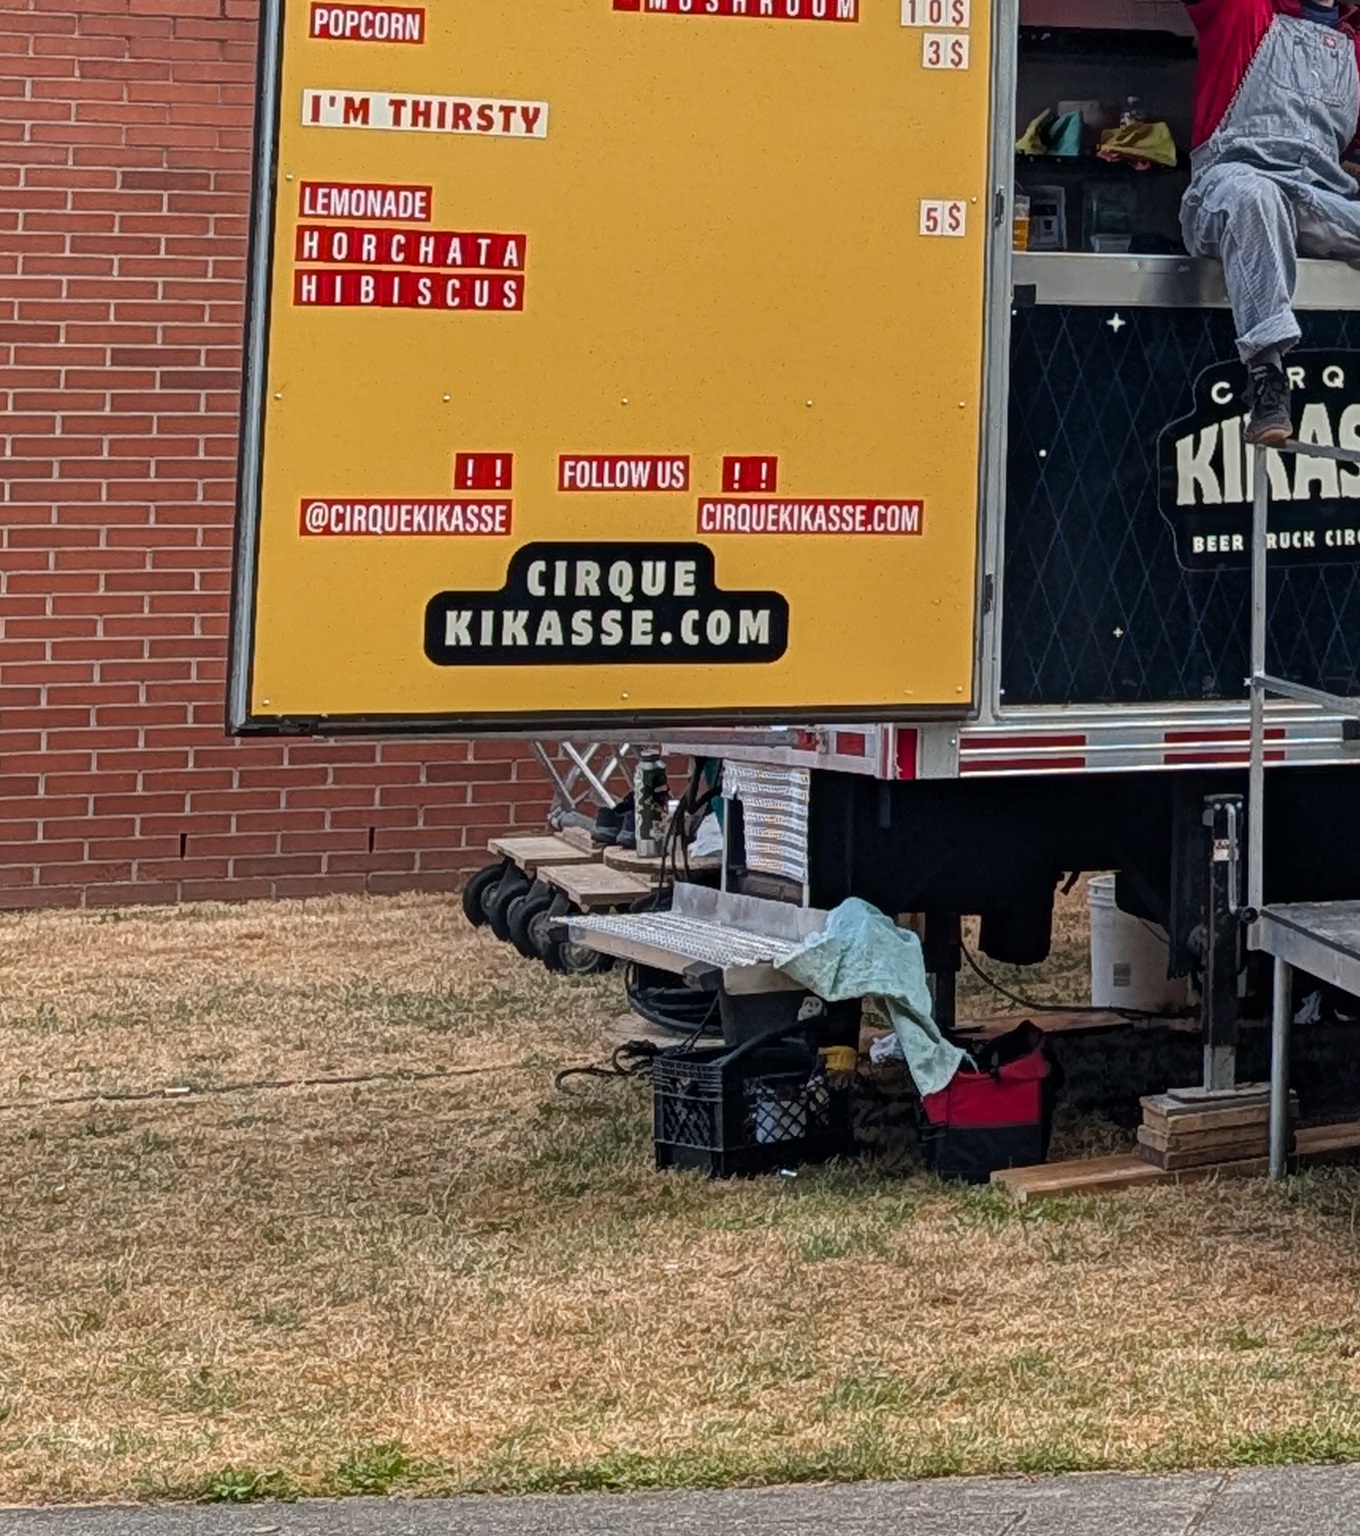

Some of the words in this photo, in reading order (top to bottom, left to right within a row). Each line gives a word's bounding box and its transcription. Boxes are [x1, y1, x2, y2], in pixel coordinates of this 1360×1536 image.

[313, 8, 422, 43] POPCORN
[927, 38, 965, 68] 3$
[310, 94, 371, 128] I'M
[387, 98, 542, 137] THIRSTY
[302, 186, 429, 219] LEMONADE
[924, 203, 964, 234] 5$
[302, 230, 521, 268] HORCHATA
[300, 273, 520, 309] HIBISCUS
[562, 459, 652, 489] FOLLOW
[656, 460, 686, 489] US
[304, 502, 507, 535] @CIRQUEKIKASSE
[700, 502, 920, 534] CIRQUEKIKASSE.COM
[1192, 535, 1245, 553] BEER
[1264, 530, 1316, 550] RUCK
[526, 560, 698, 604] CIRQUE
[444, 609, 771, 647] KIKASSE.COM
